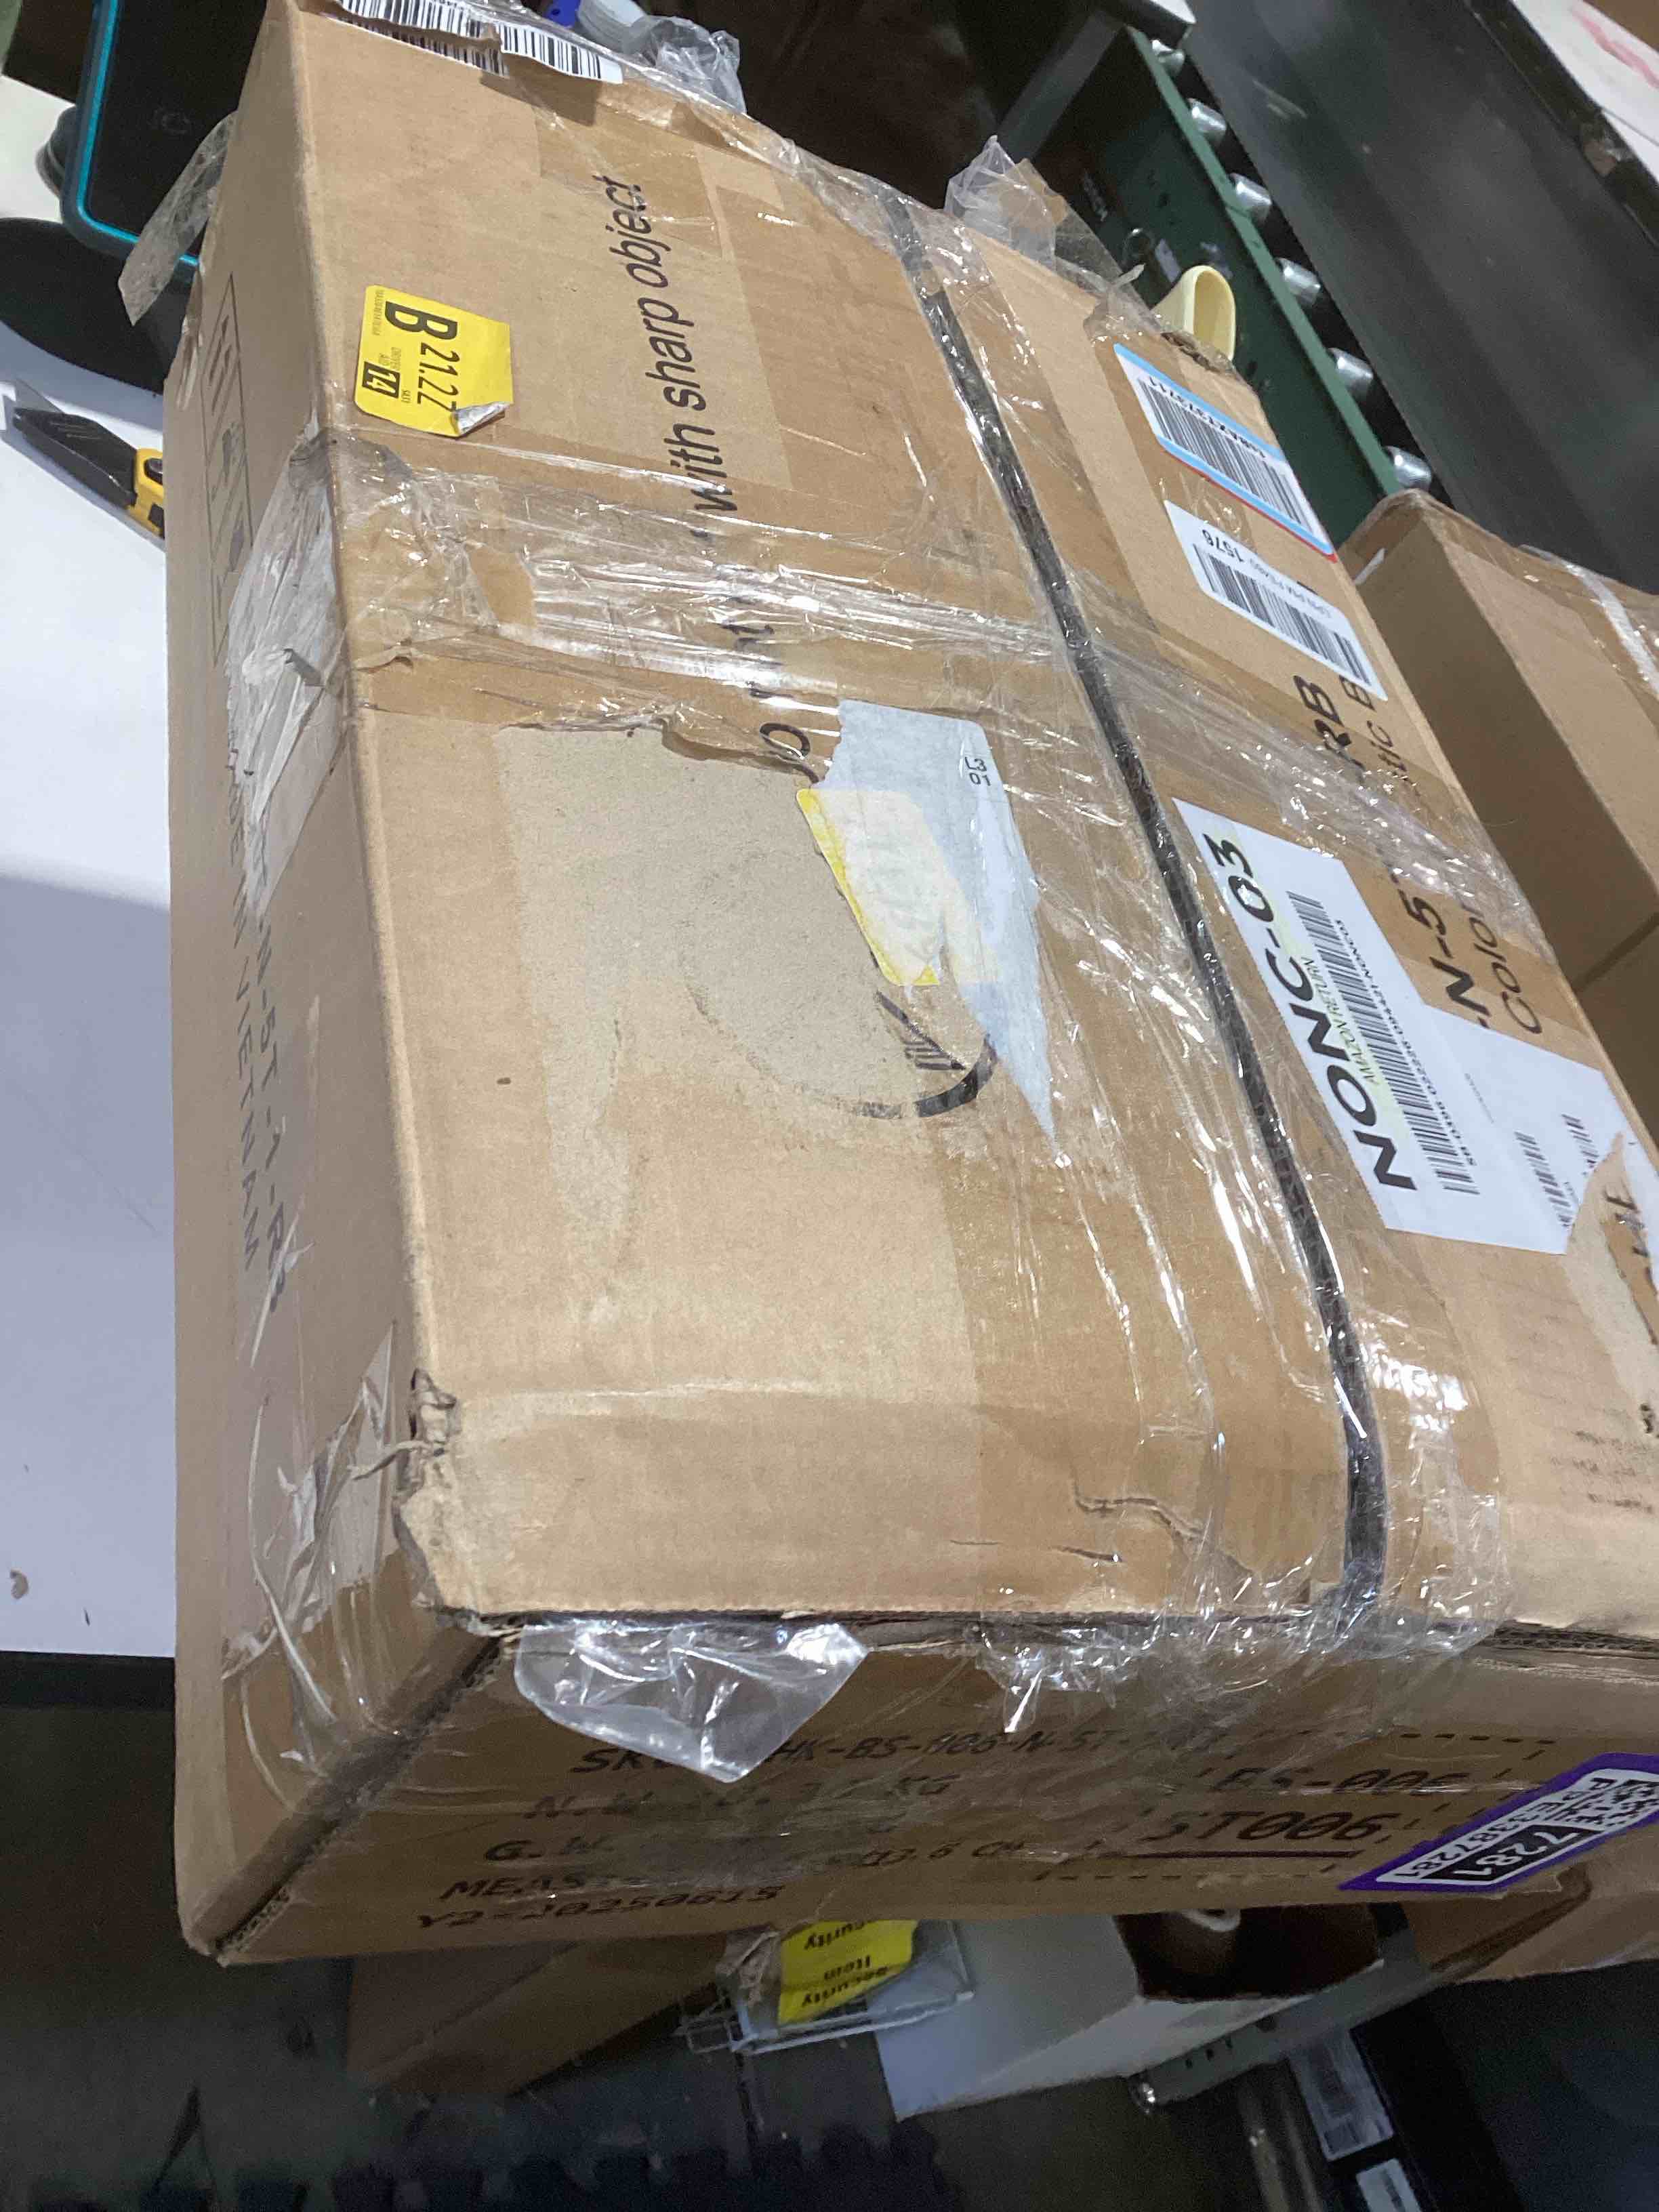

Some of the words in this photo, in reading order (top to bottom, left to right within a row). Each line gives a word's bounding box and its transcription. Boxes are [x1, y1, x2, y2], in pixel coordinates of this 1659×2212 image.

[592, 173, 672, 289] object
[384, 300, 458, 340] B
[636, 297, 707, 411] sharp
[361, 362, 401, 398] 14
[664, 423, 738, 512] with
[1202, 833, 1417, 1191] NONC-03
[1300, 956, 1339, 1015] RETURN
[1336, 1019, 1380, 1085] AMAZON
[236, 955, 260, 1272] VIETNAM
[1452, 1831, 1580, 1877] 7281
